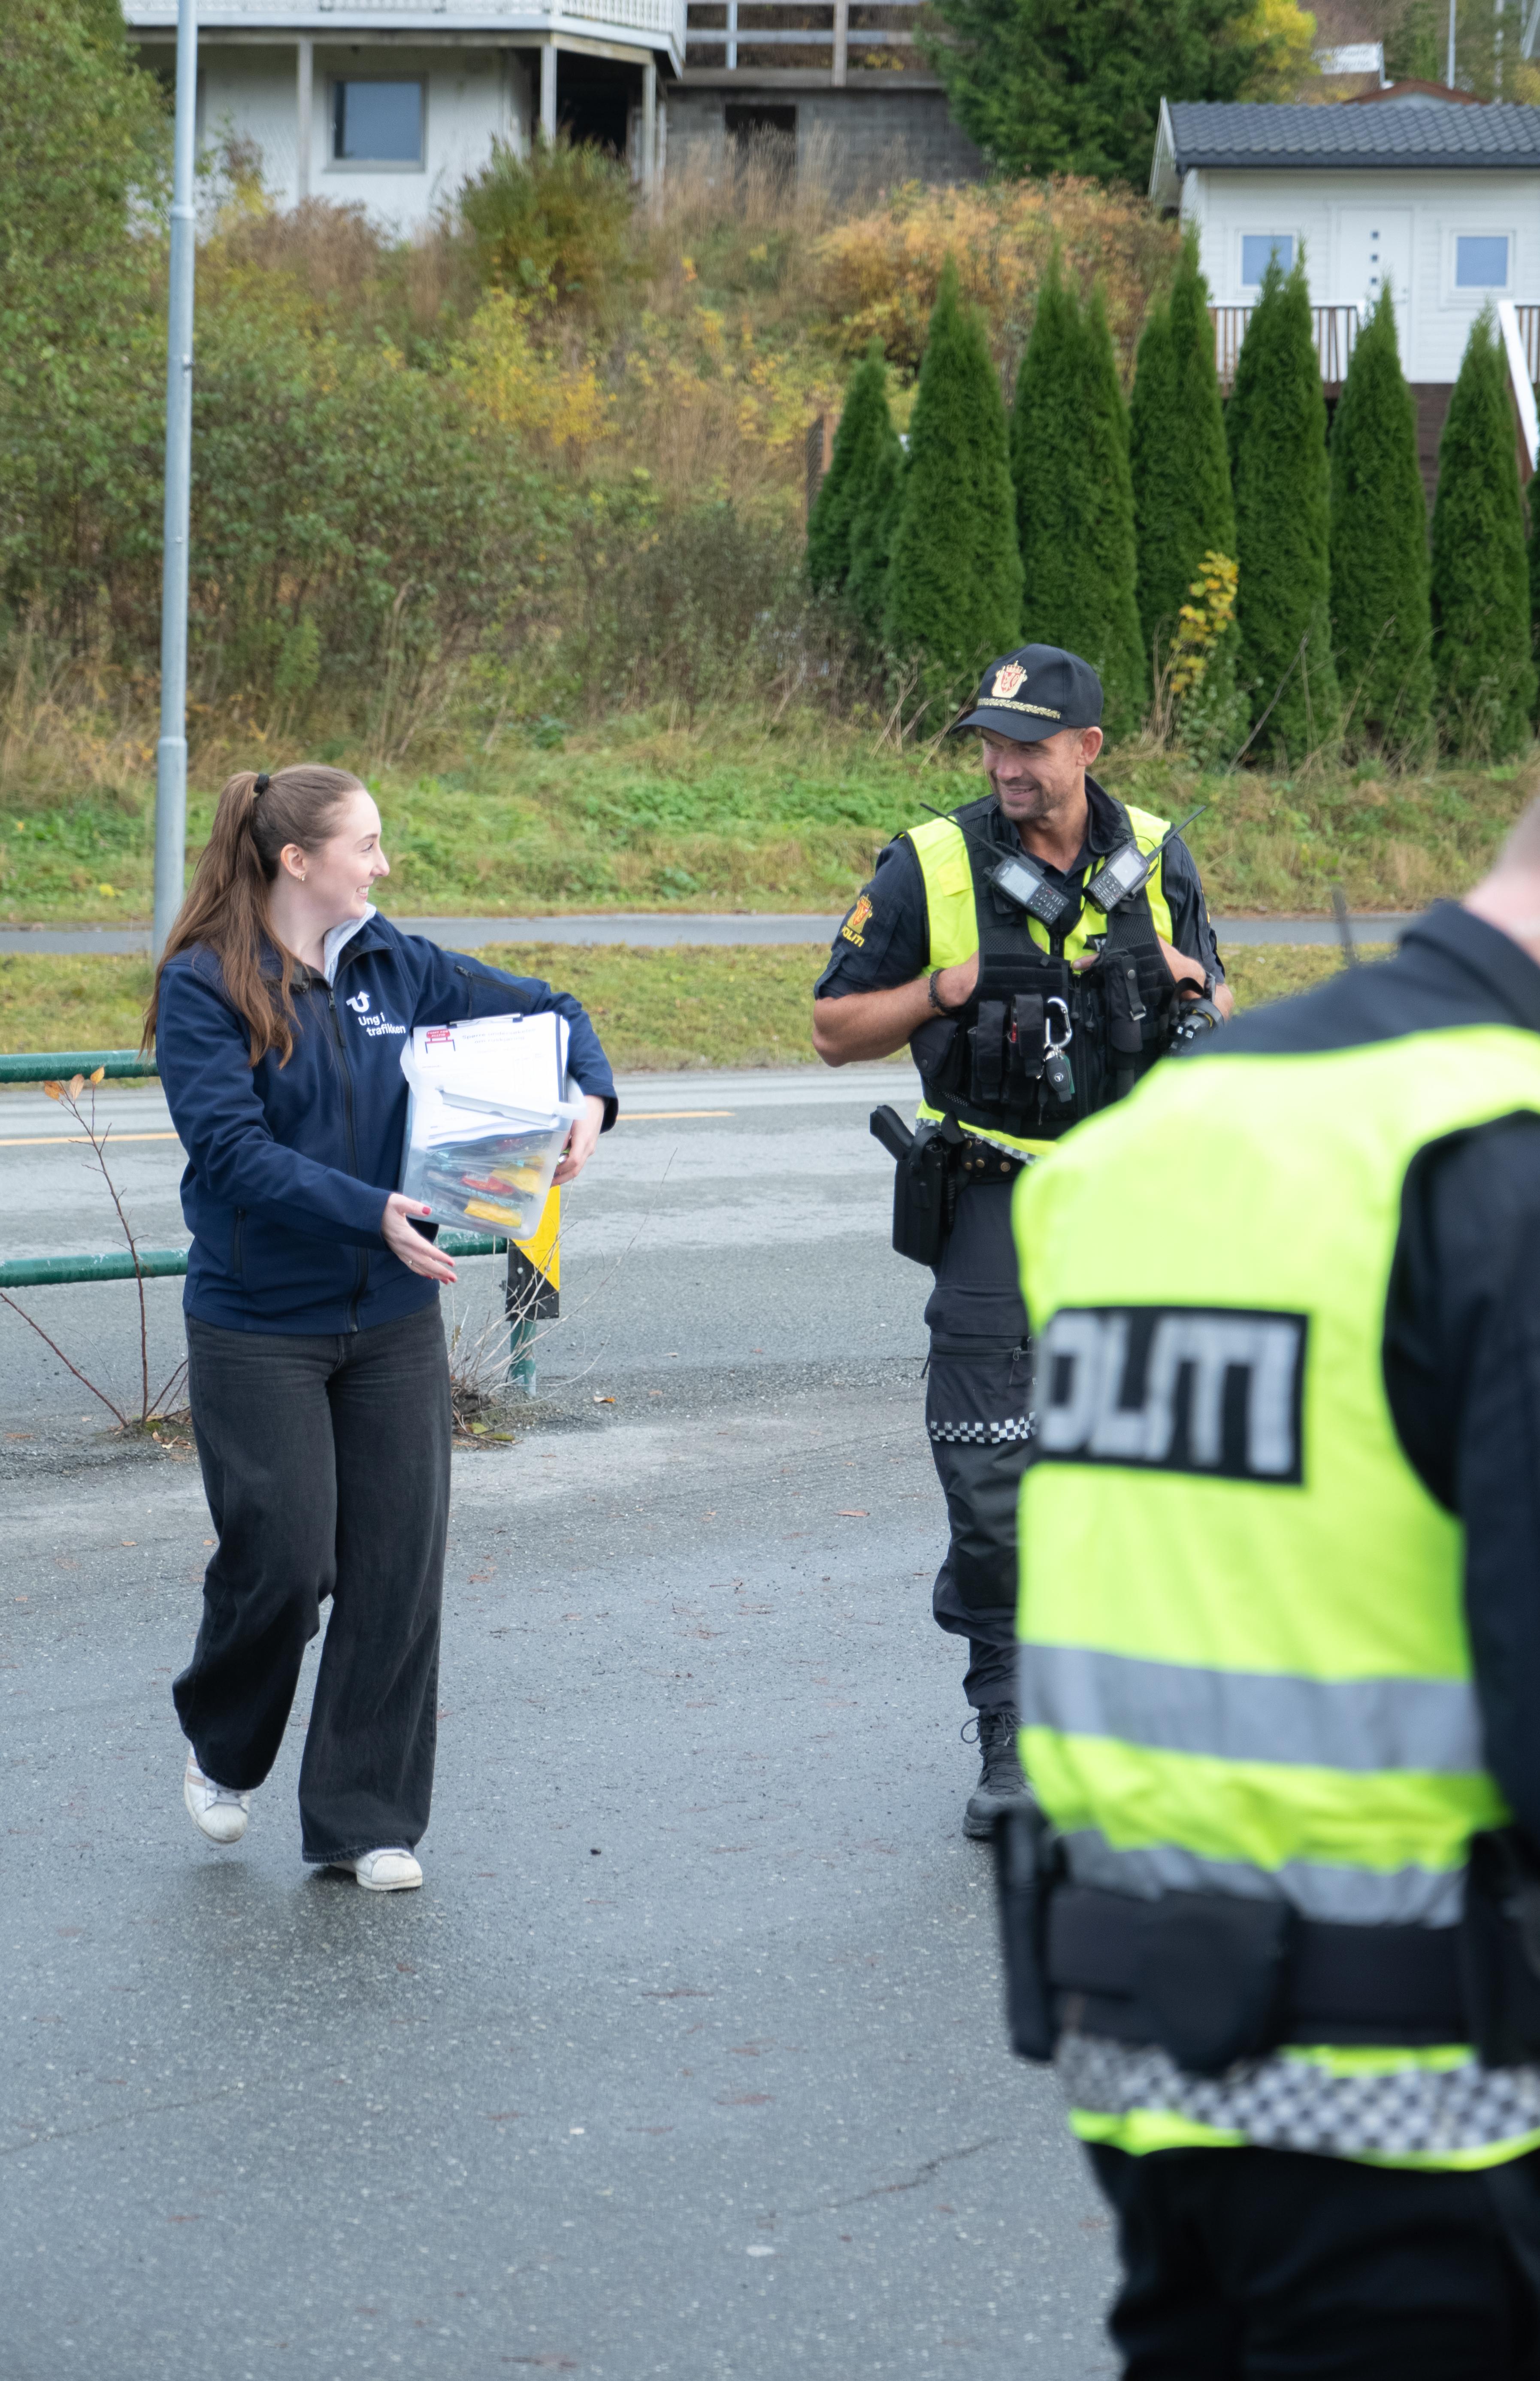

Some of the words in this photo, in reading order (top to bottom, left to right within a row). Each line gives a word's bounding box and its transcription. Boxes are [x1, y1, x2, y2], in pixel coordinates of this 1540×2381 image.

[358, 1016, 380, 1026] Ung
[380, 1012, 385, 1022] i
[366, 1023, 406, 1036] trafikken
[1038, 1311, 1299, 1475] OLITI
